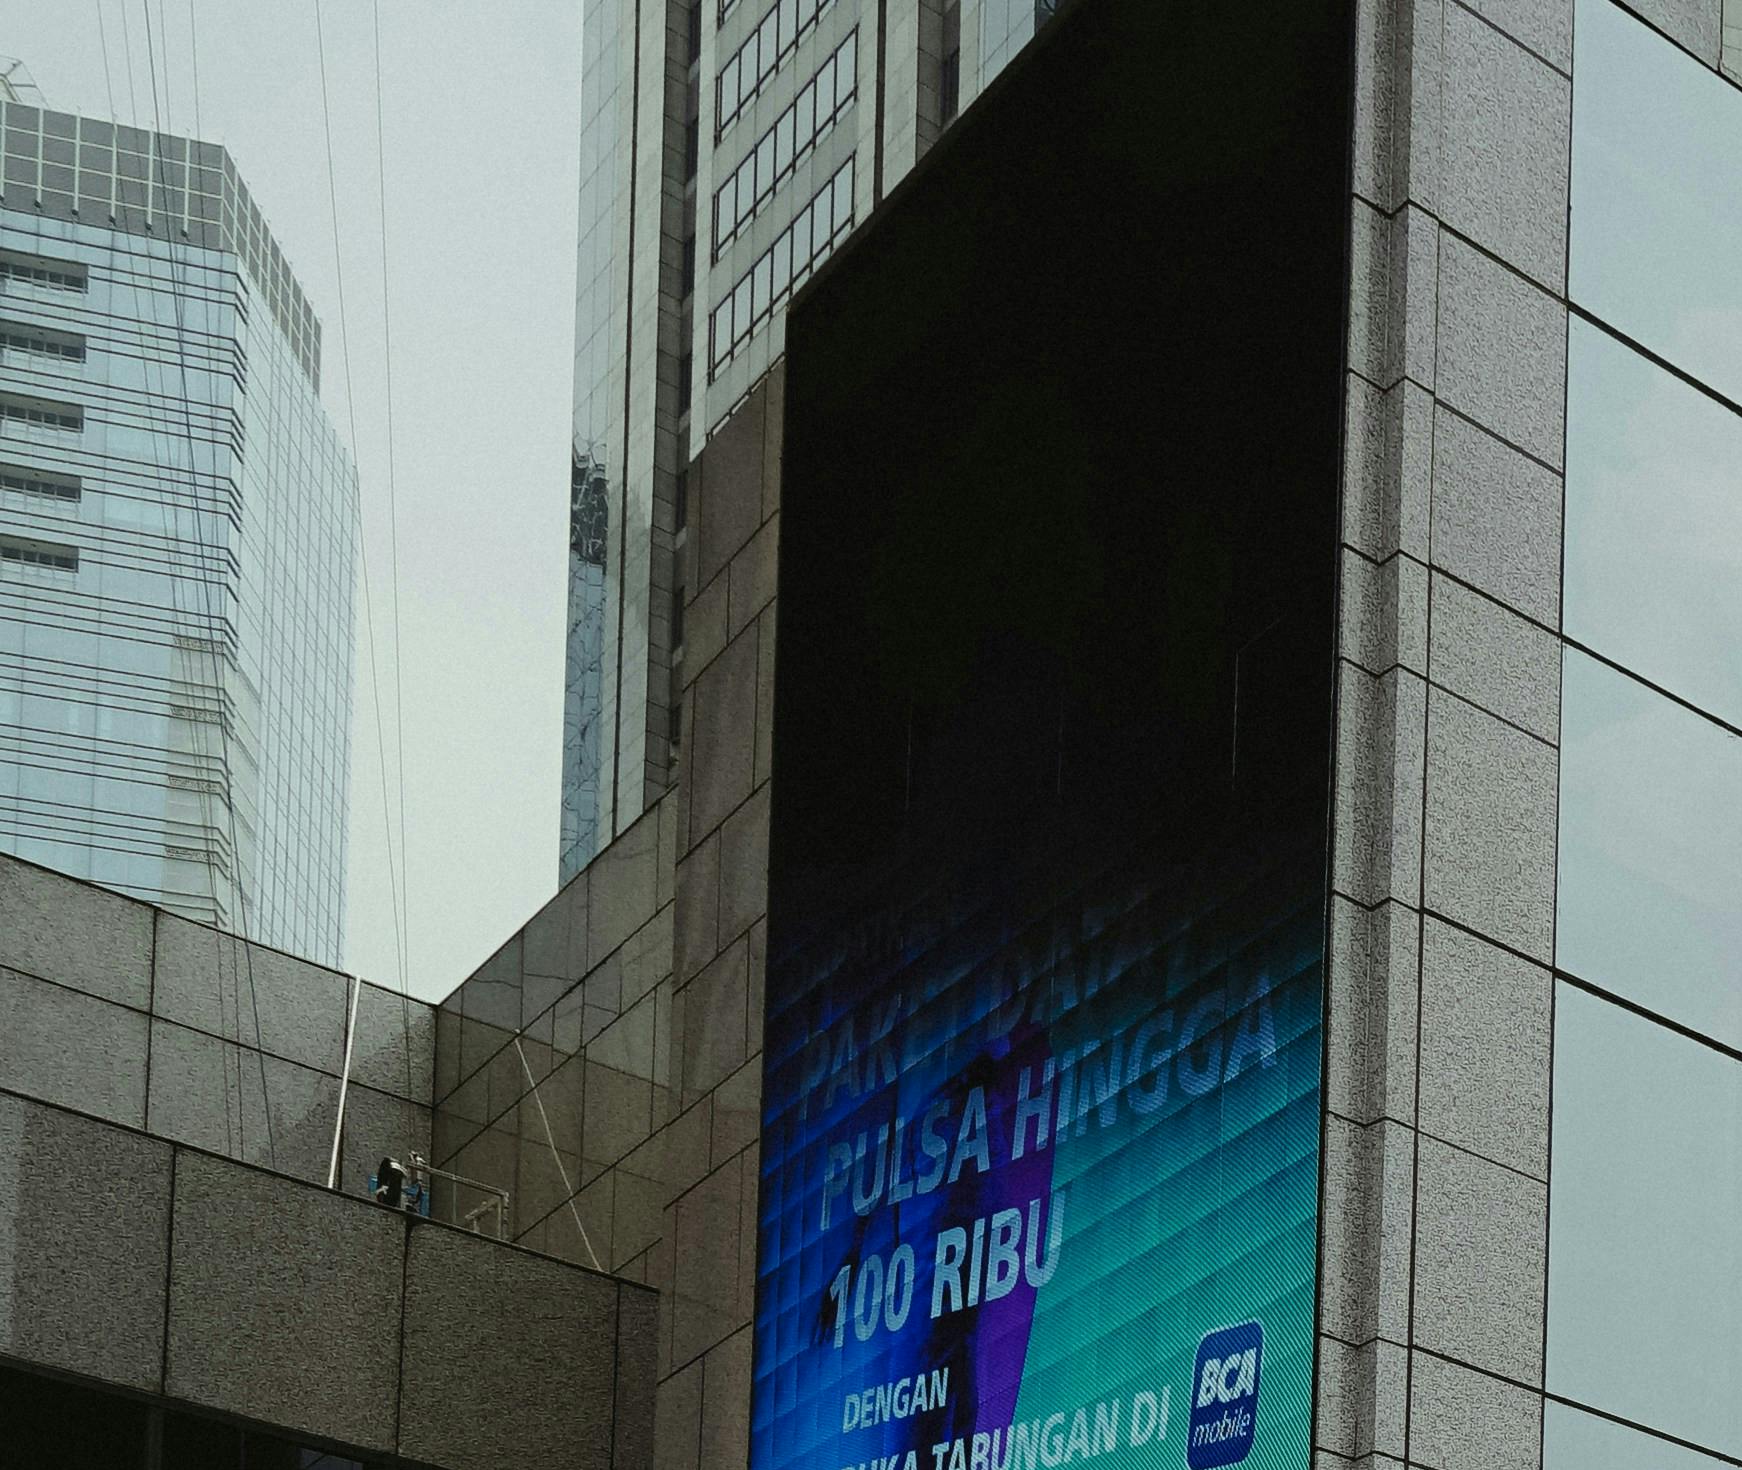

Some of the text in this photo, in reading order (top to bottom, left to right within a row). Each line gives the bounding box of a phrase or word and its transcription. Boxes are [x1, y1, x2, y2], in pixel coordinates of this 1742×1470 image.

[820, 1086, 990, 1231] PULSA
[1011, 973, 1277, 1161] HINGGA
[829, 1187, 1067, 1349] 100 RIBU
[842, 1366, 949, 1433] DENGAN
[1196, 1347, 1258, 1408] BCA
[1130, 1384, 1172, 1446] DI
[1193, 1405, 1251, 1448] mobile
